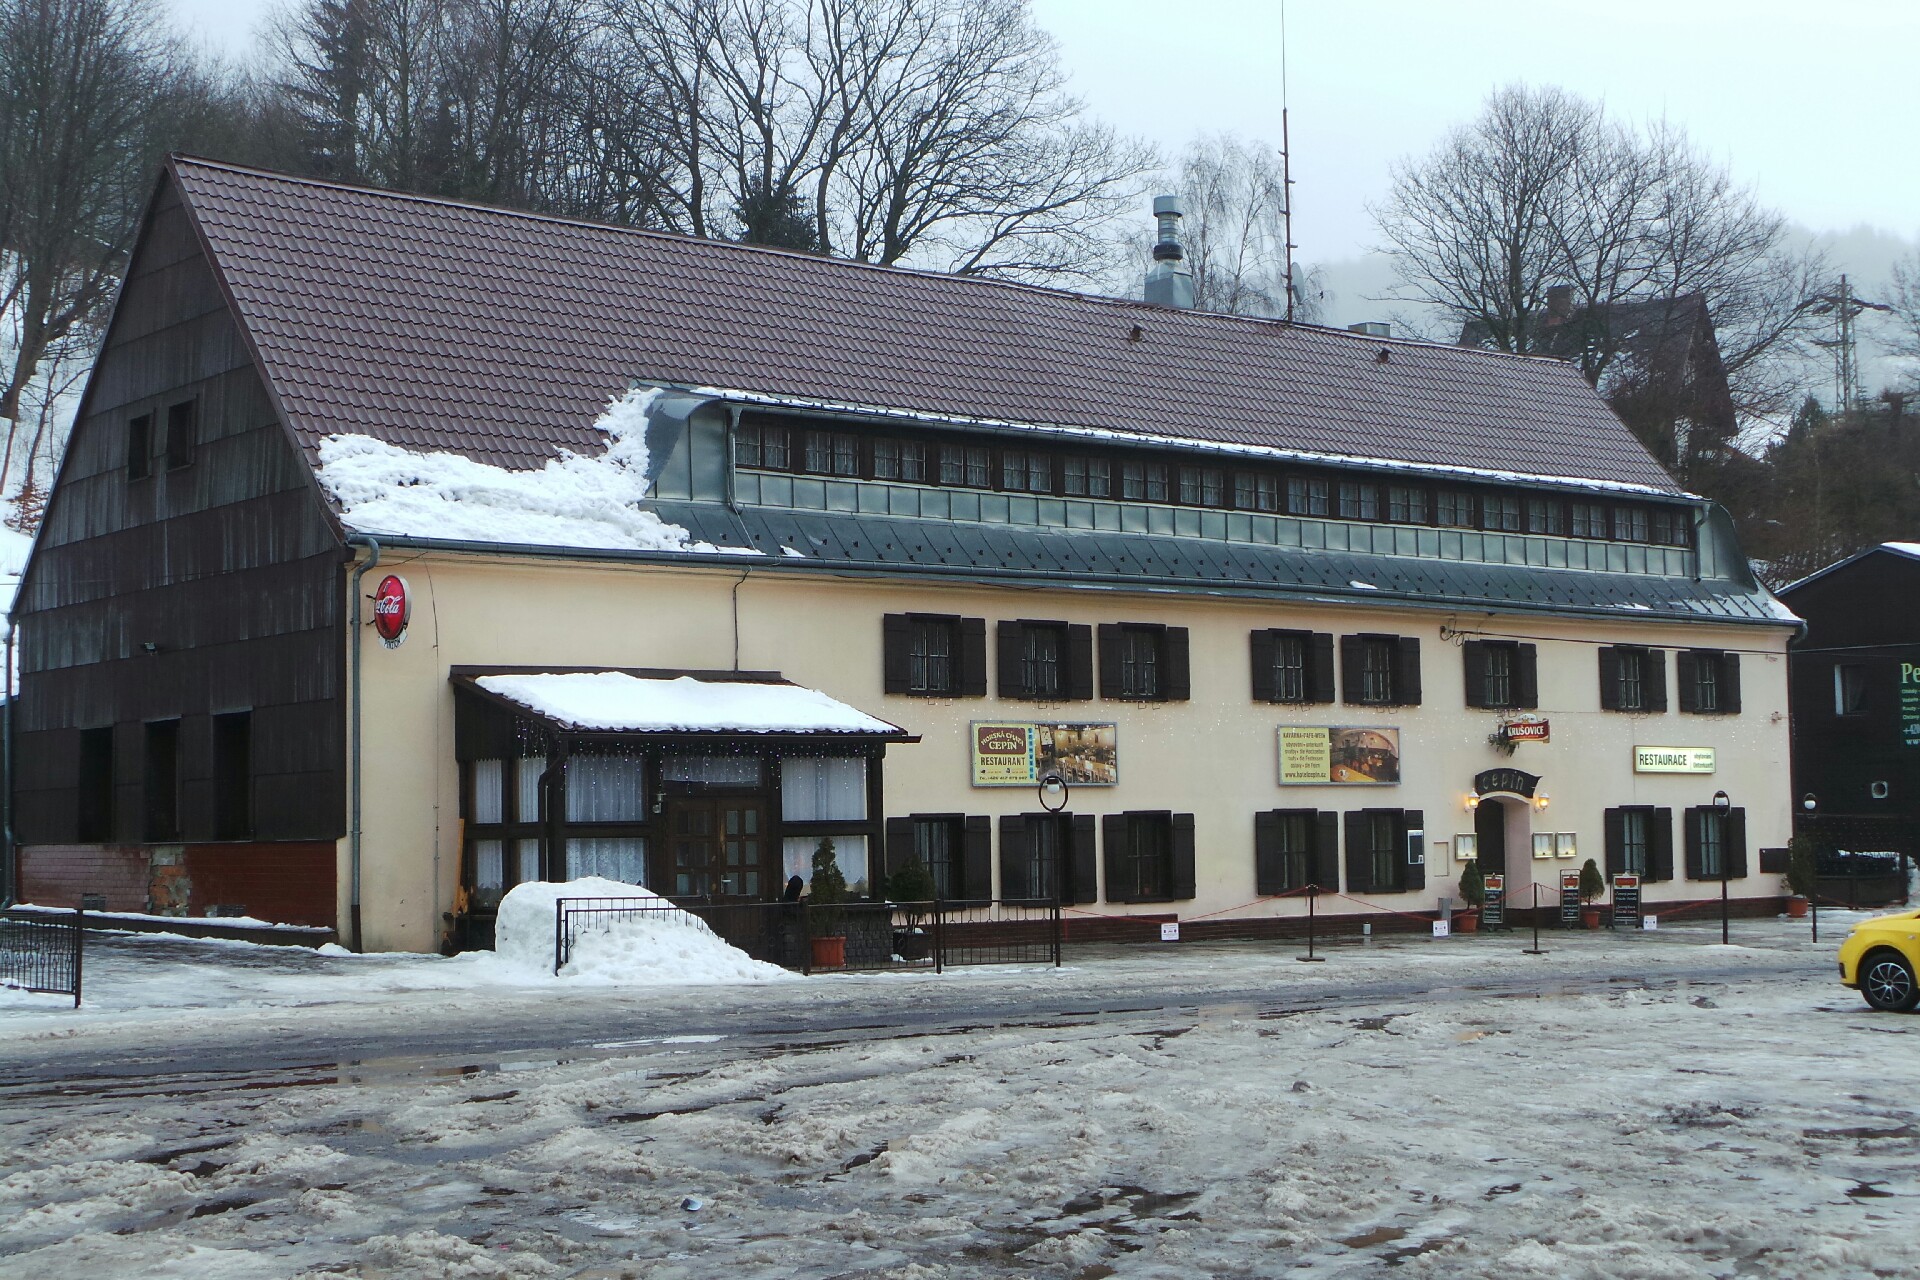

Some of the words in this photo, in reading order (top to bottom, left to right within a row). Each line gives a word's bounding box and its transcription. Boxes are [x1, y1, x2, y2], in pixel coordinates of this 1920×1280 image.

[1507, 725, 1544, 736] KRUŠOVICE
[980, 756, 1026, 766] RESTAURANT
[1639, 754, 1687, 766] RESTAURACE
